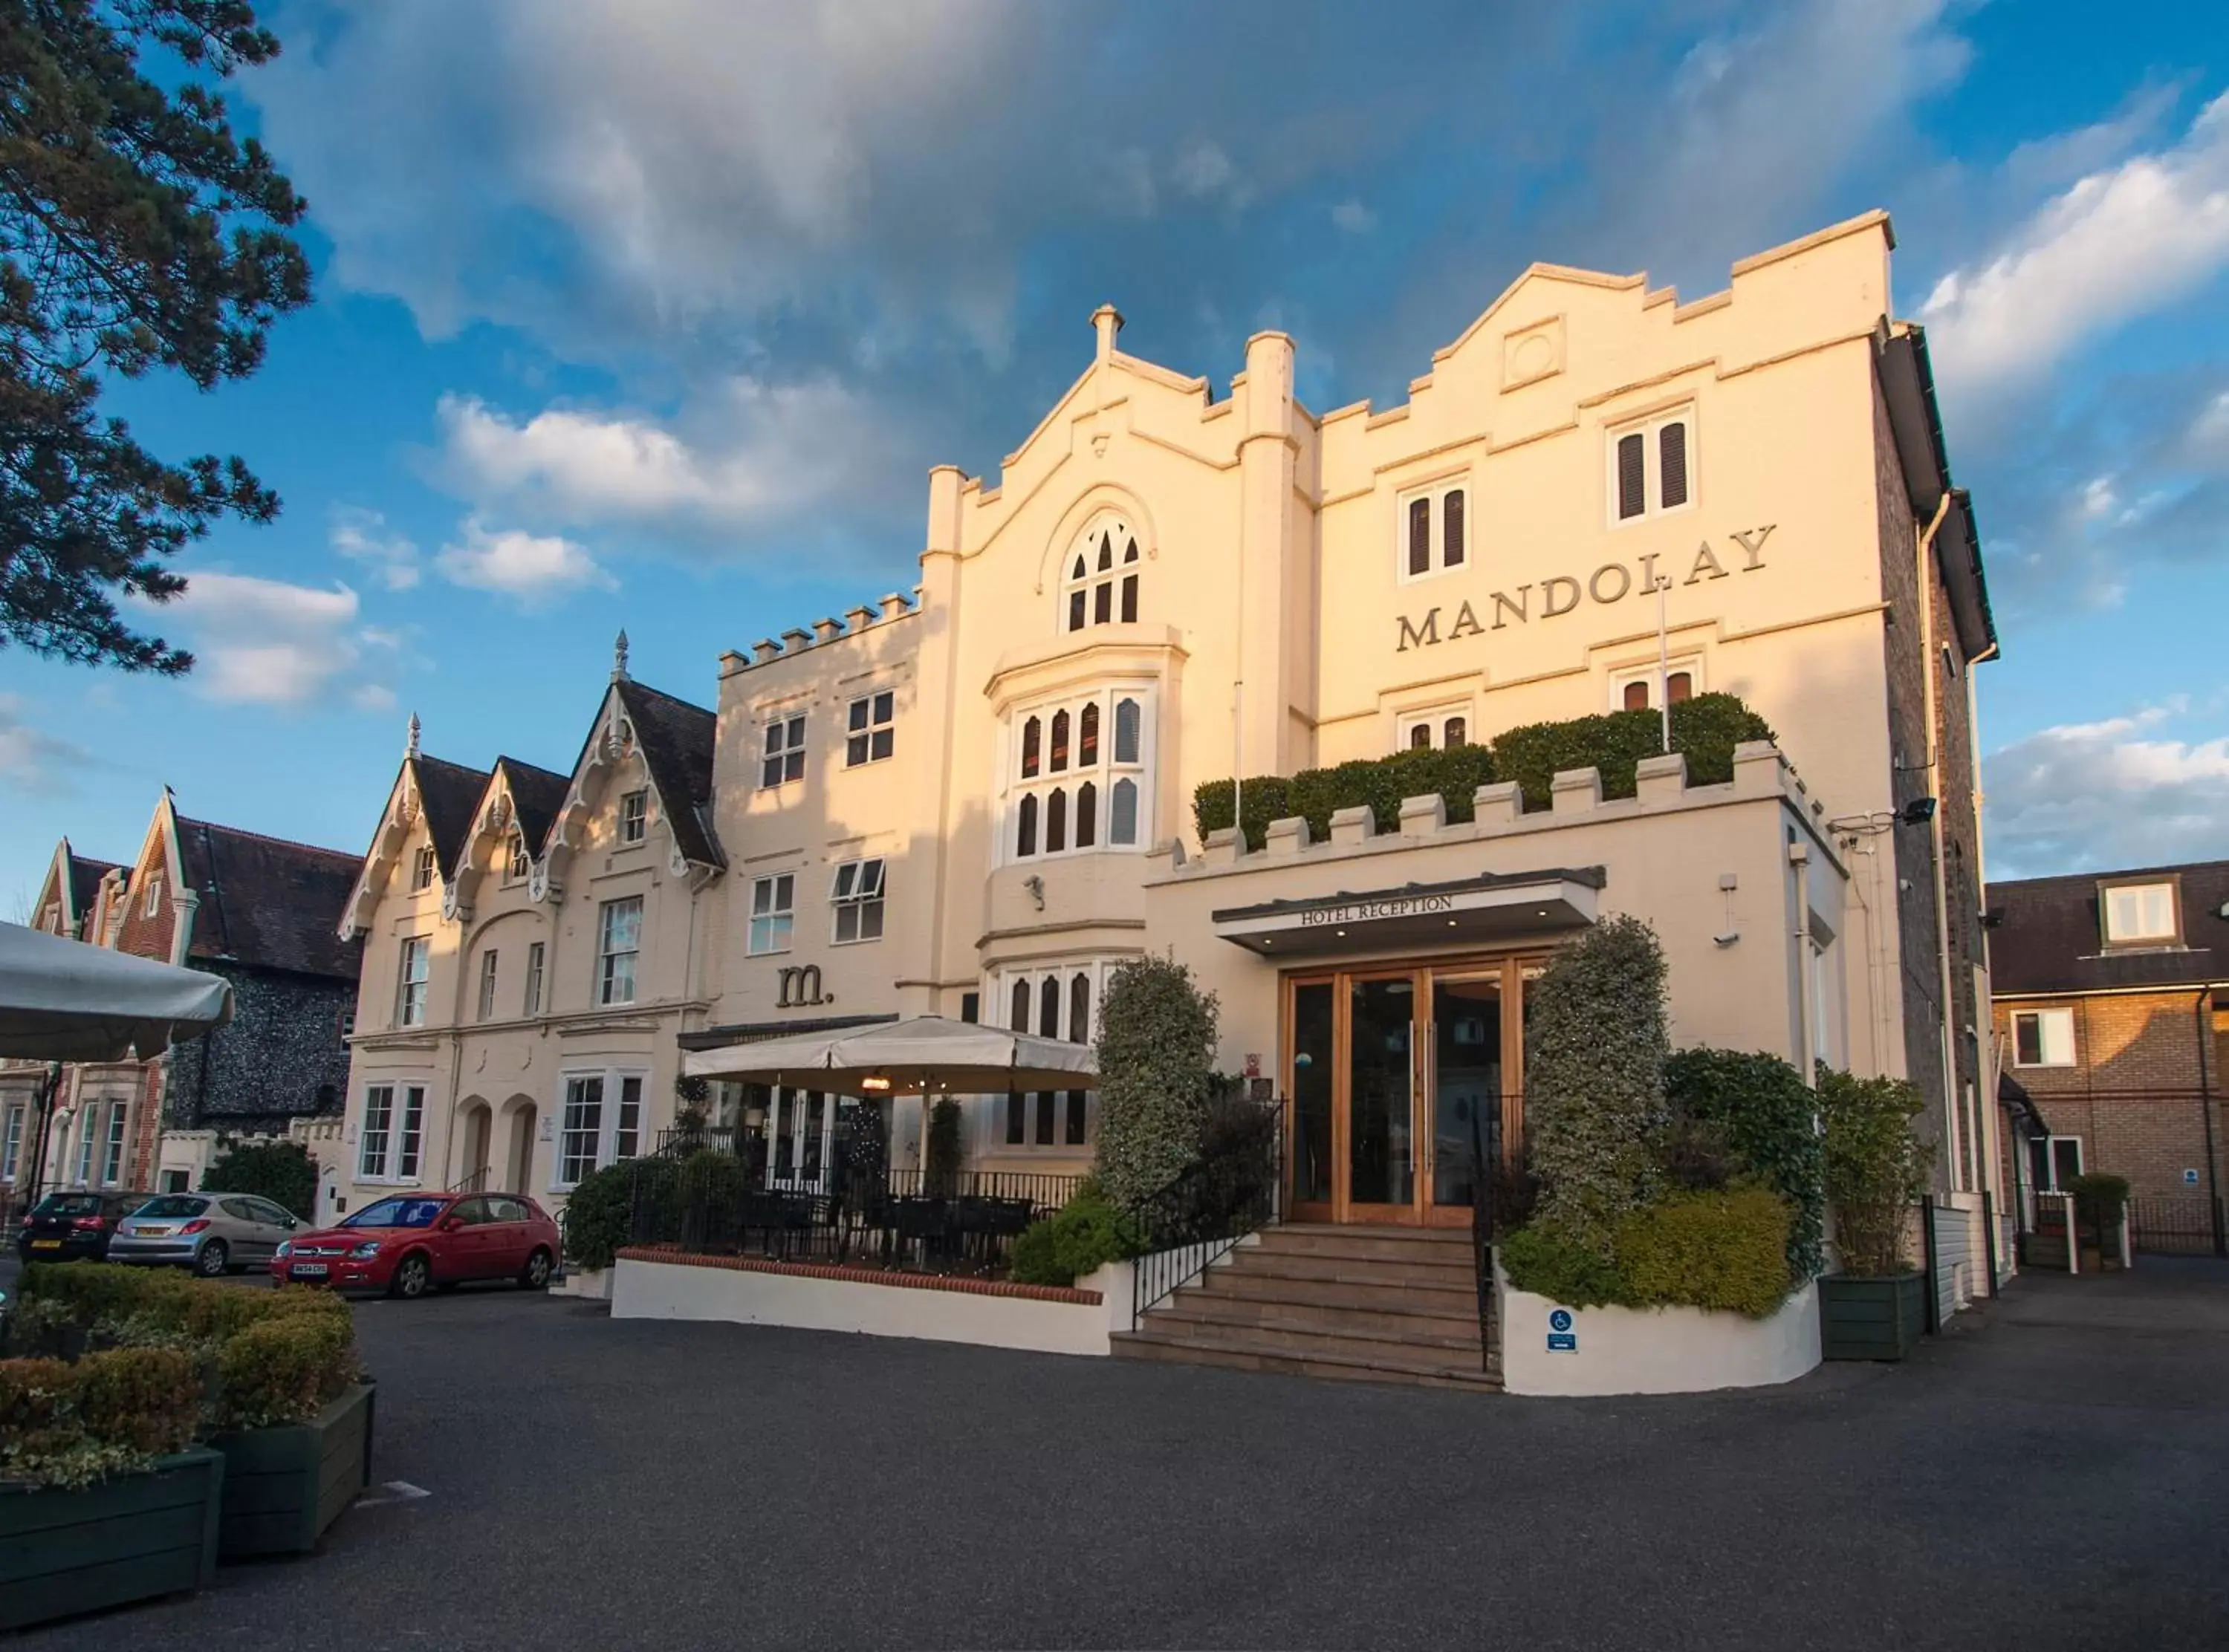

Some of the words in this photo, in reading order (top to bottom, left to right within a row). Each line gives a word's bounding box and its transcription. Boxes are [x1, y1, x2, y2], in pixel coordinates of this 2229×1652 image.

[1396, 524, 1777, 653] MANDOLAY
[1302, 907, 1352, 925] HOTEL
[1359, 897, 1452, 918] RECEPTION
